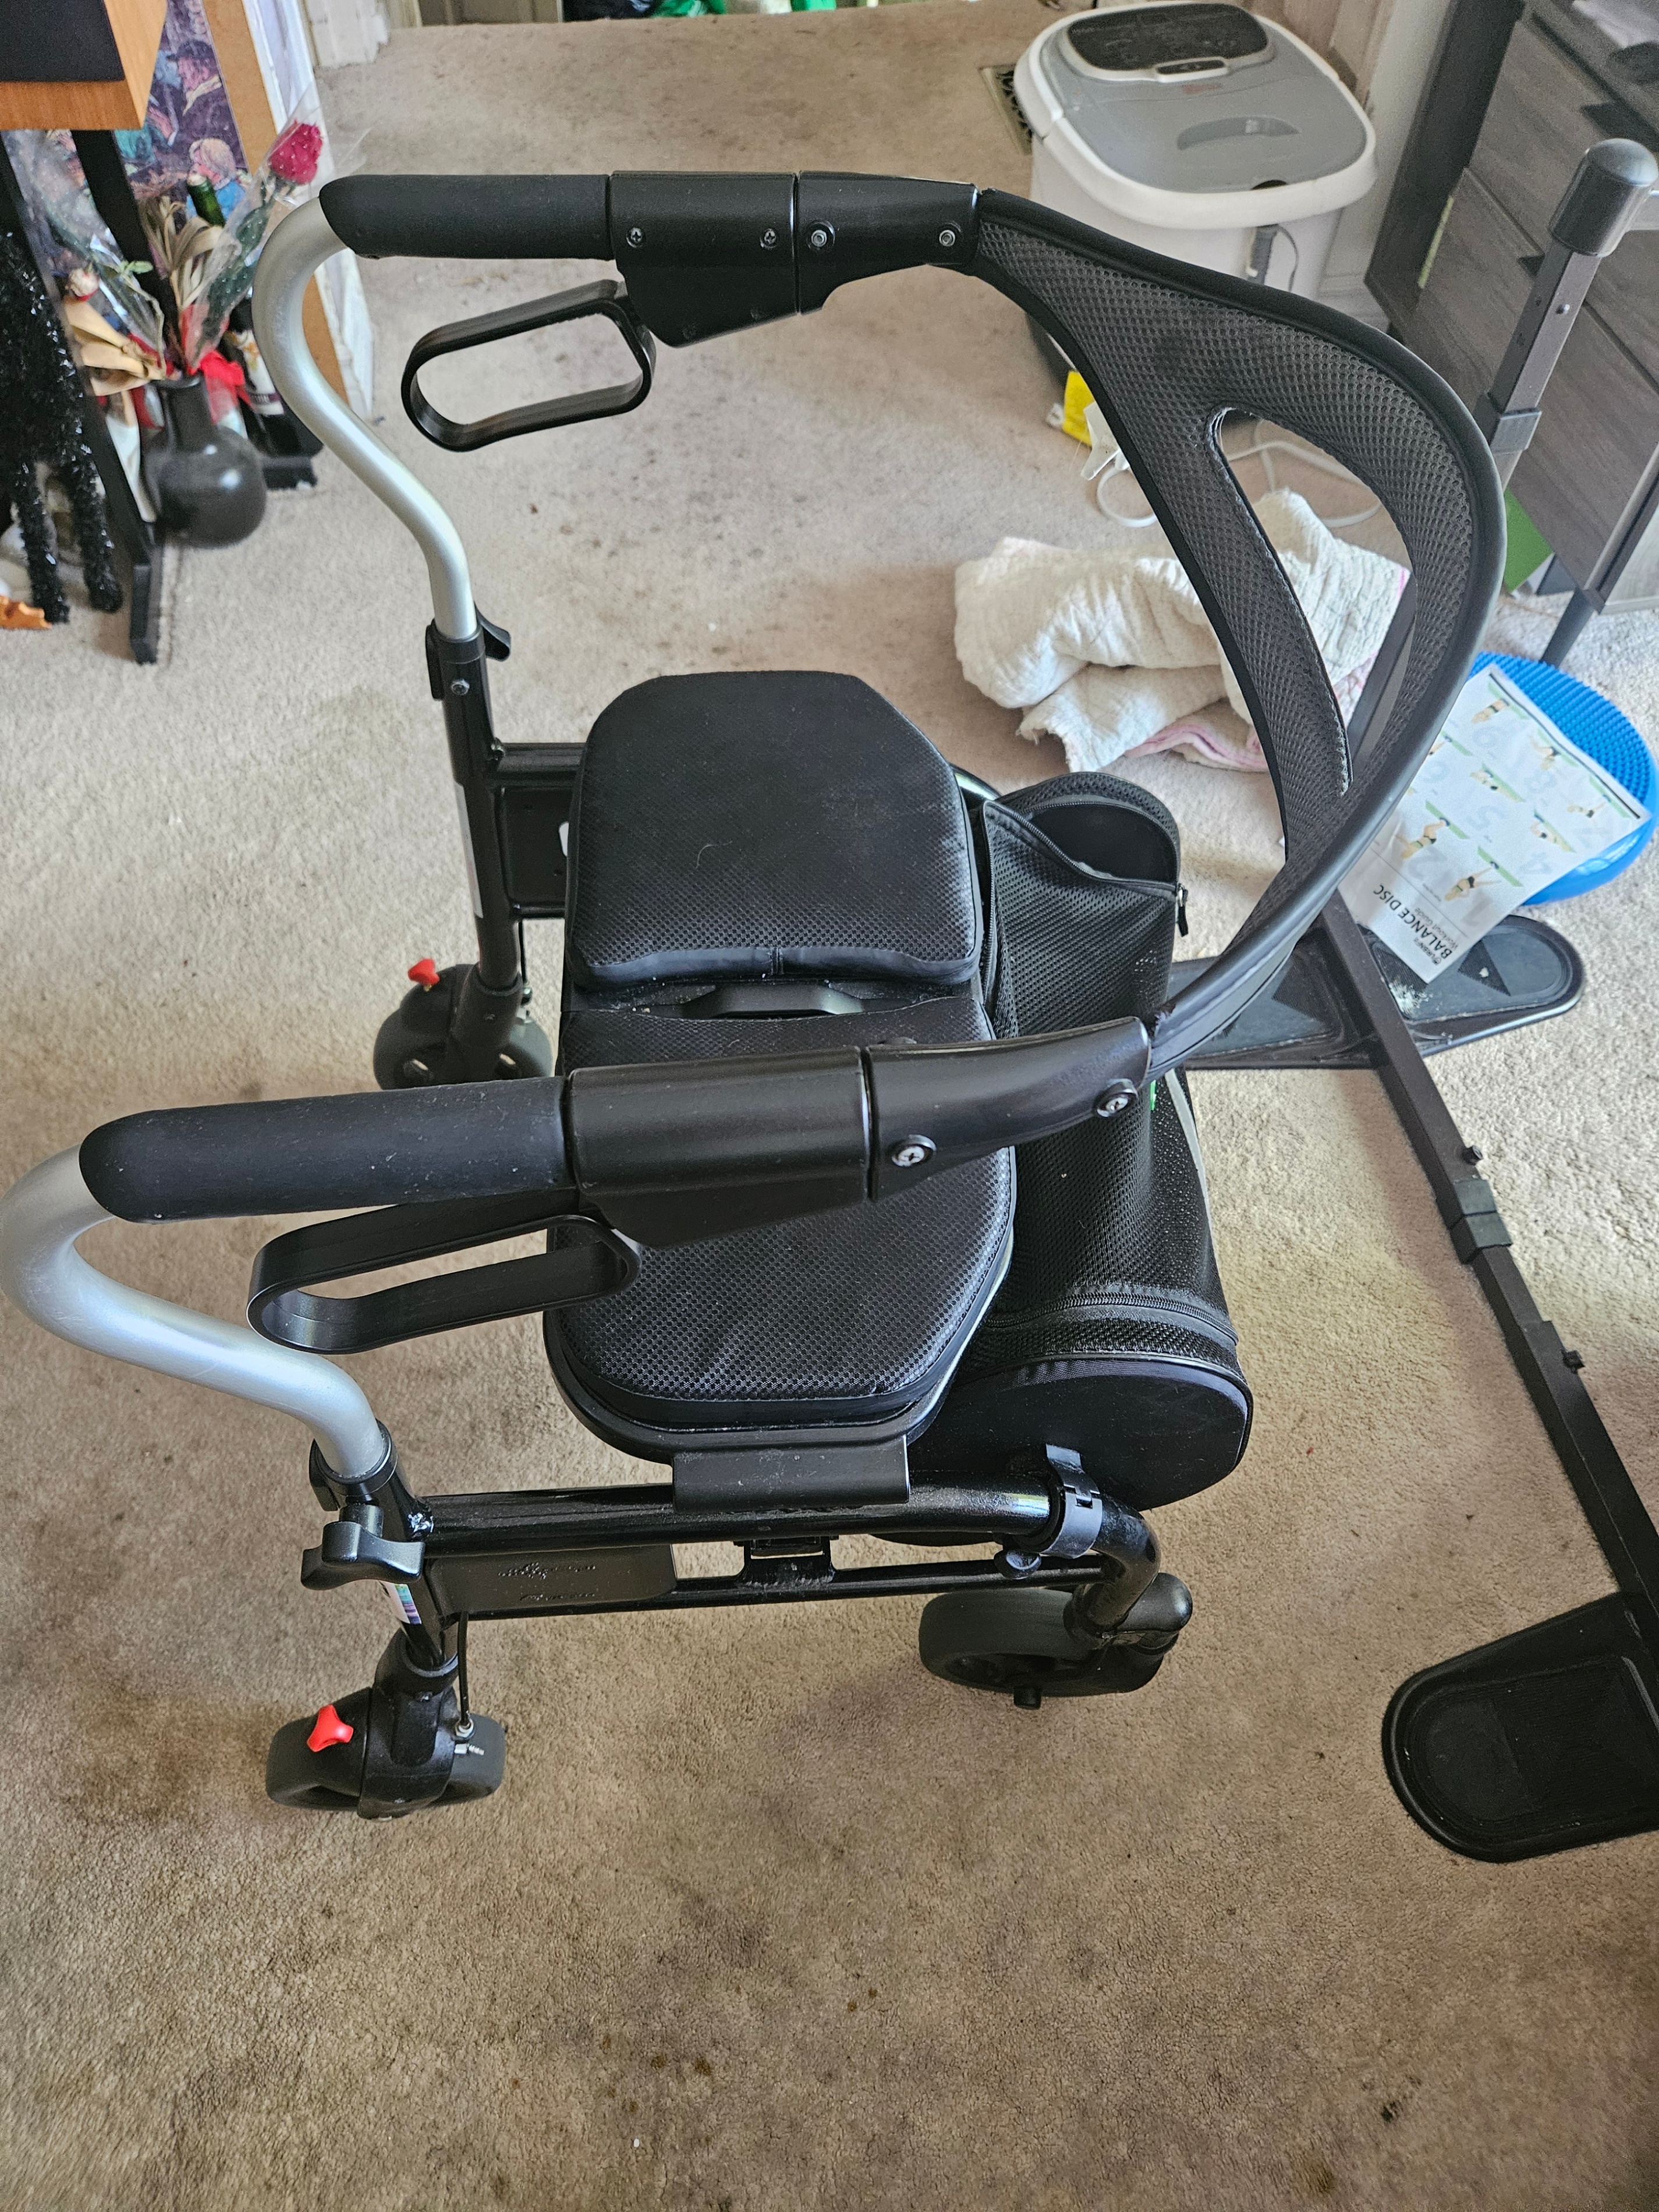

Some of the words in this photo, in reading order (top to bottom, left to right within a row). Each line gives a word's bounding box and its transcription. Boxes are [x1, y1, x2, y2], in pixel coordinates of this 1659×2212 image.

[1466, 806, 1508, 830] 5
[1408, 846, 1447, 880] 2
[1373, 883, 1402, 911] DISC
[1415, 908, 1433, 926] Guide
[1398, 908, 1452, 959] BALANCE
[1433, 924, 1458, 949] Workout
